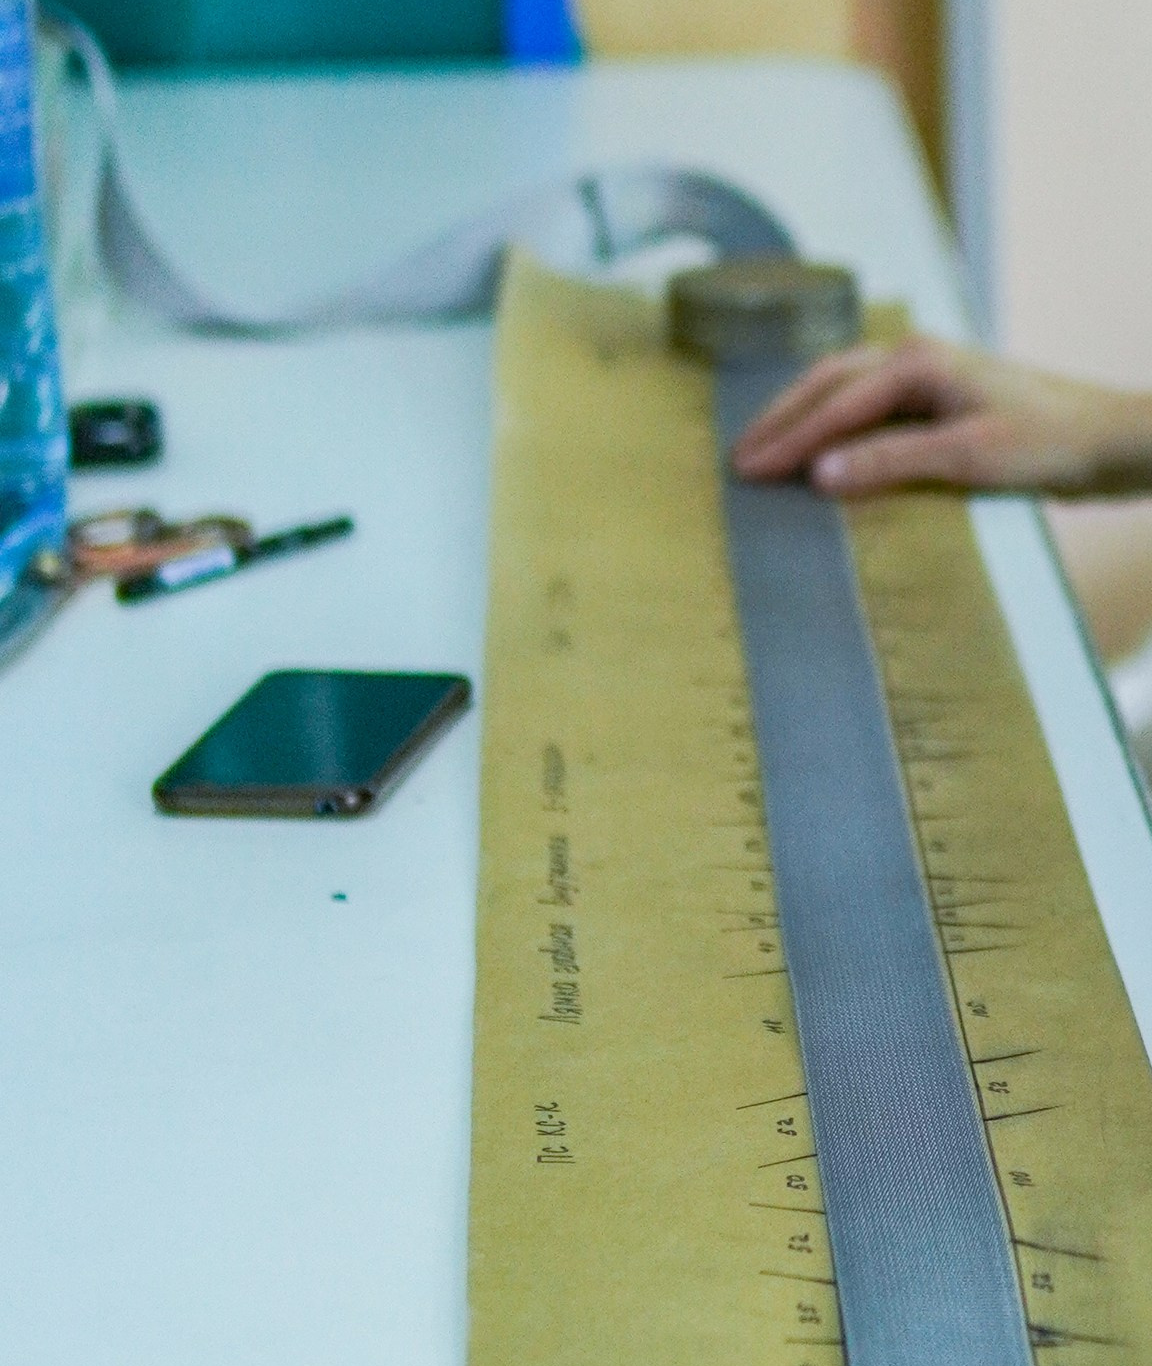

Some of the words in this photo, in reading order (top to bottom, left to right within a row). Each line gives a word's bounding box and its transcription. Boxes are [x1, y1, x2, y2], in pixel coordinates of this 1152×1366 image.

[987, 1081, 1011, 1095] 52
[776, 1117, 798, 1137] 52
[786, 1174, 808, 1192] 50
[788, 1233, 813, 1255] 52
